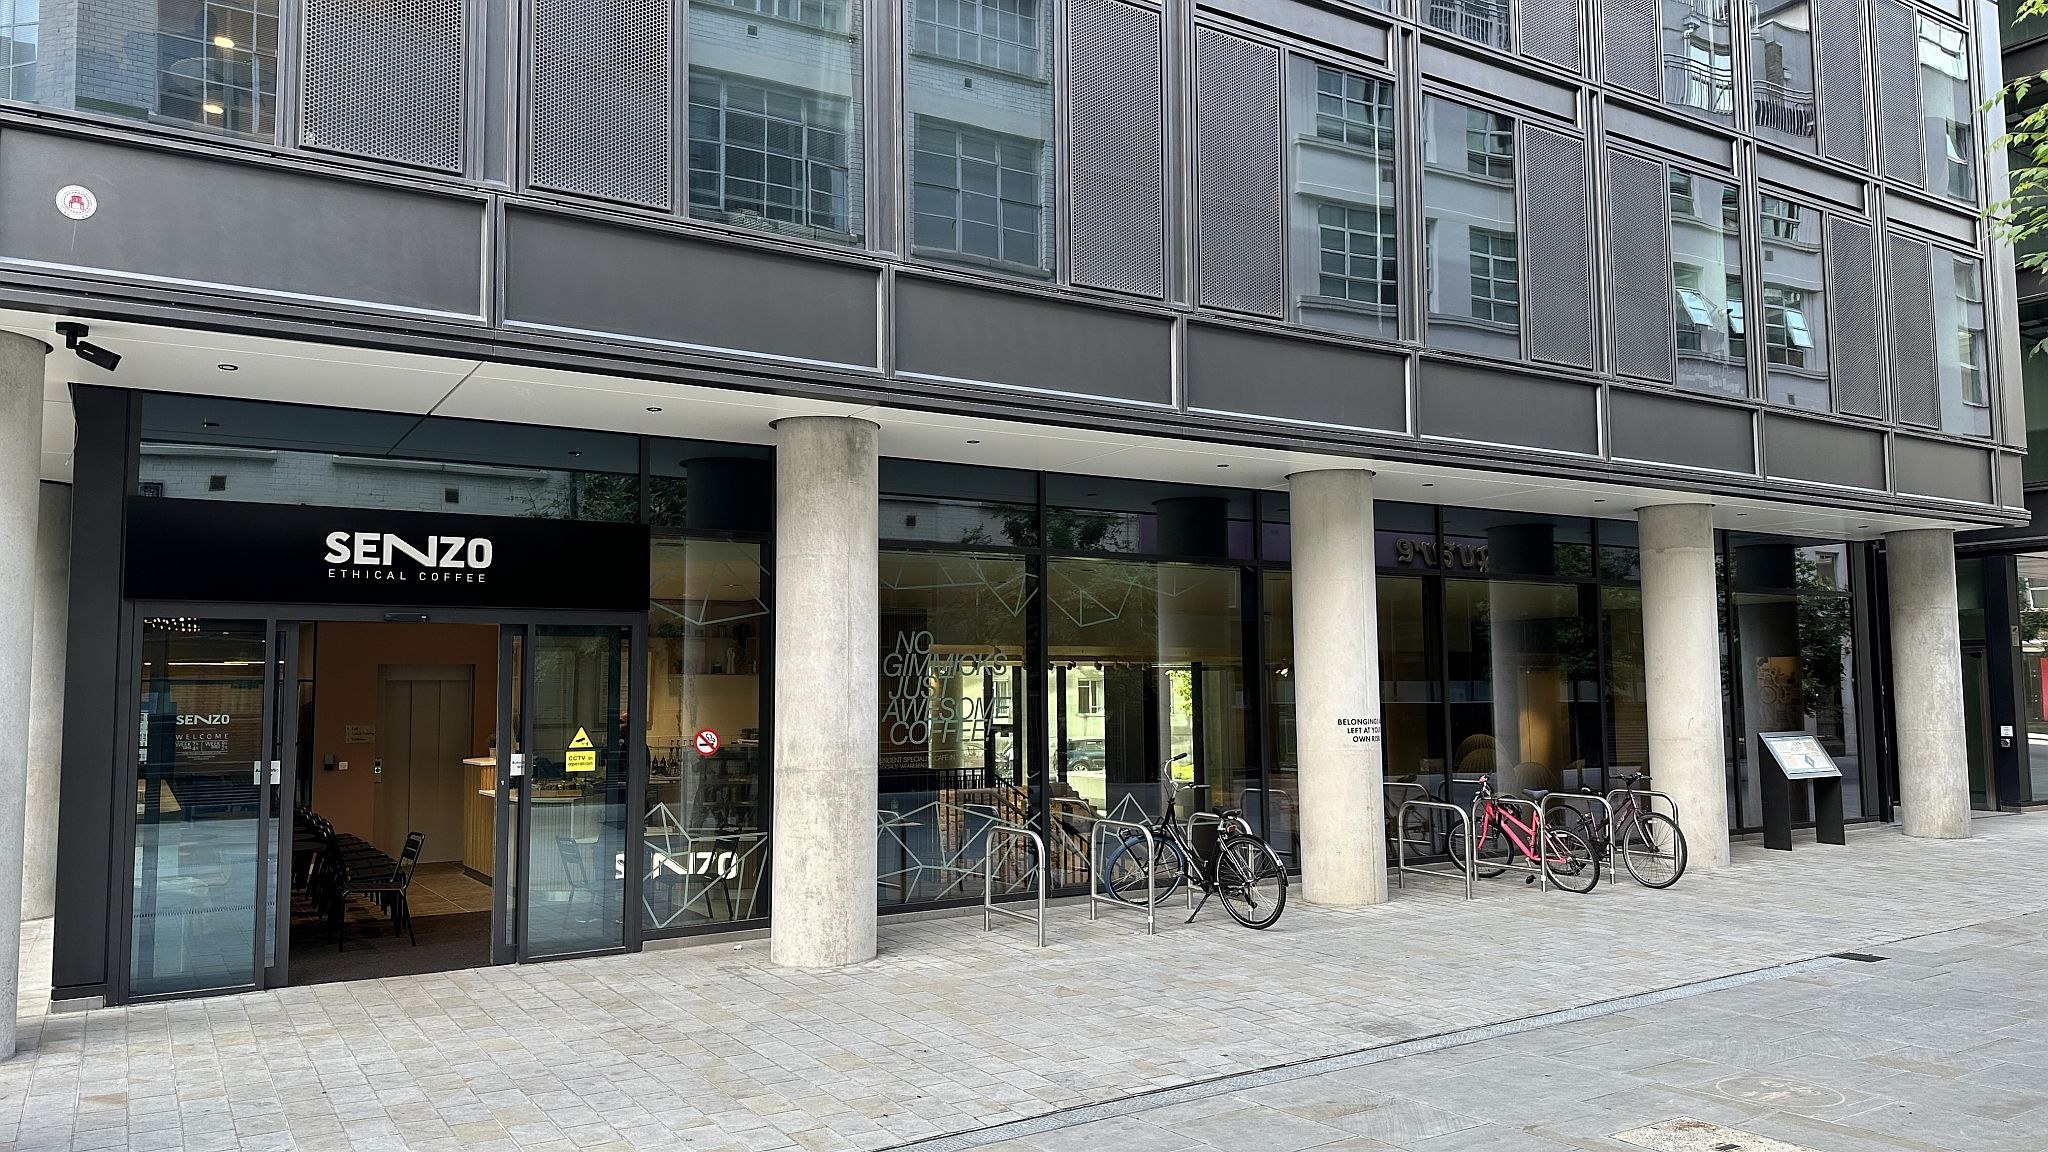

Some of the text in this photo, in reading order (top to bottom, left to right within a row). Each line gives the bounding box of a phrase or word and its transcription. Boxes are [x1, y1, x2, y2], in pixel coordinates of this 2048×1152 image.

[324, 531, 493, 569] SENZO
[328, 568, 486, 583] ETHICAL COFFEE
[895, 630, 935, 655] NO
[883, 652, 1008, 677] GIMMICKS
[888, 674, 955, 700] JUST
[175, 714, 230, 726] SENZO
[881, 696, 1012, 723] AWESOME
[175, 733, 229, 741] WELCOME
[1352, 735, 1371, 743] OWN
